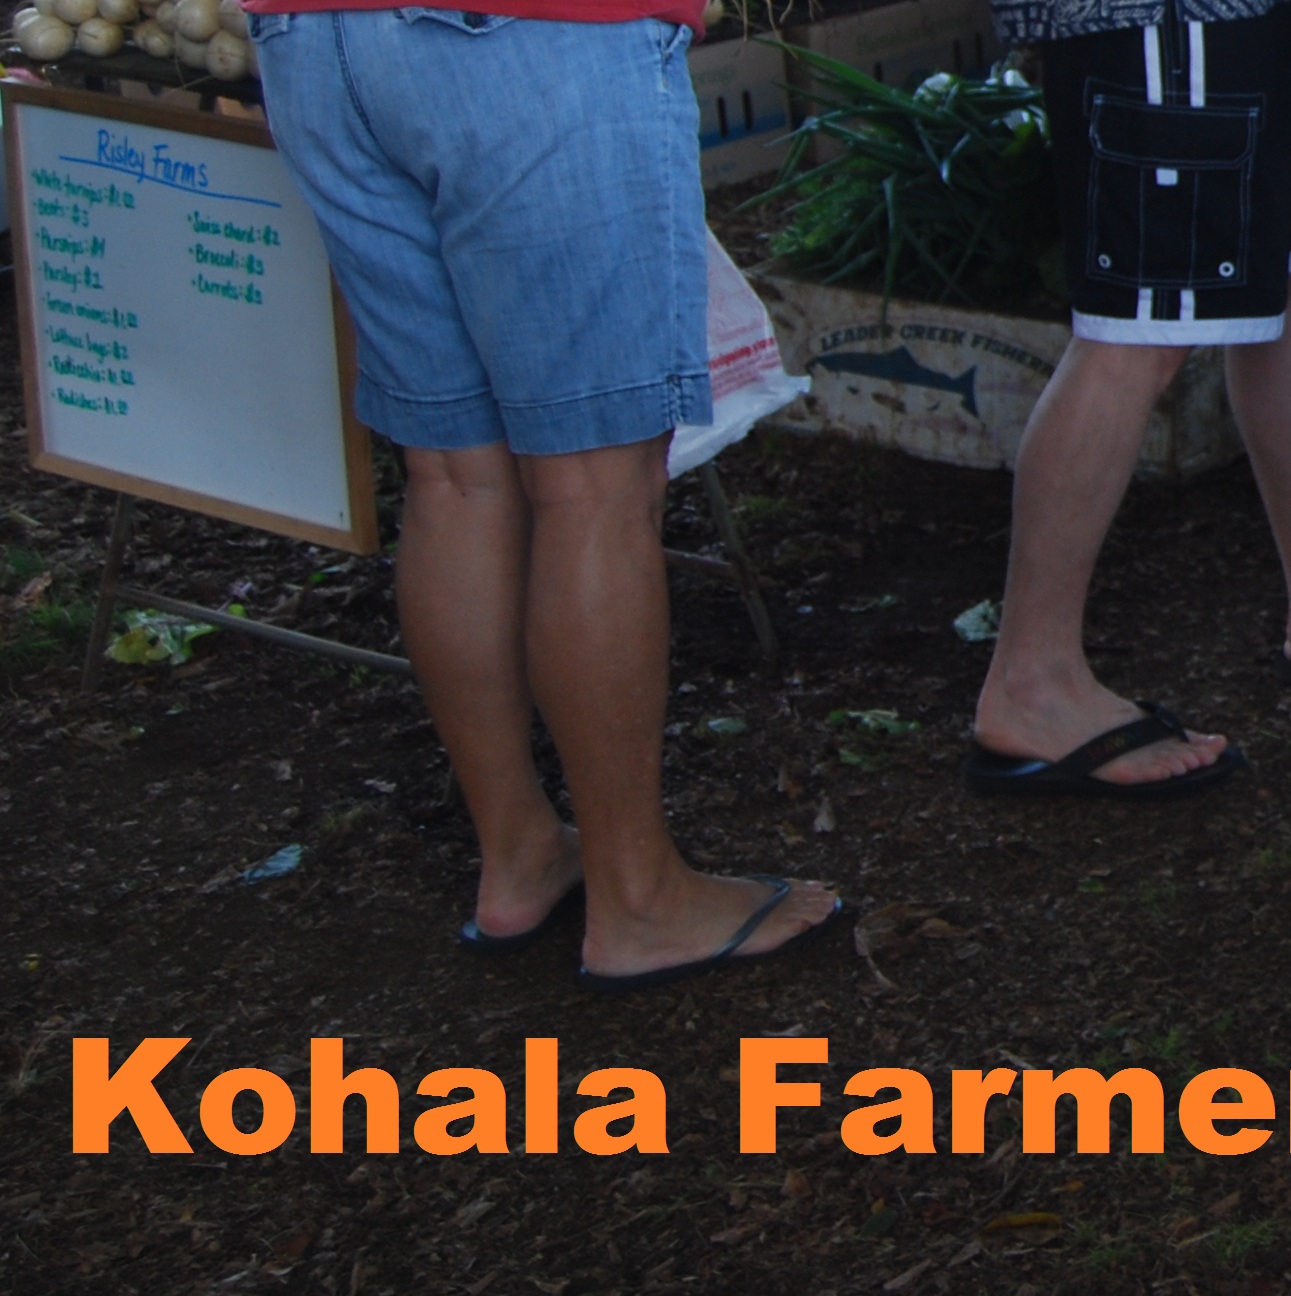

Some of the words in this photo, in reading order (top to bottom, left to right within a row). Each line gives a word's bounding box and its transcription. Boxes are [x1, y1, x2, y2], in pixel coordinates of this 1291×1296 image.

[97, 128, 146, 184] Risley
[152, 143, 209, 188] Farms
[901, 323, 965, 345] CREEK
